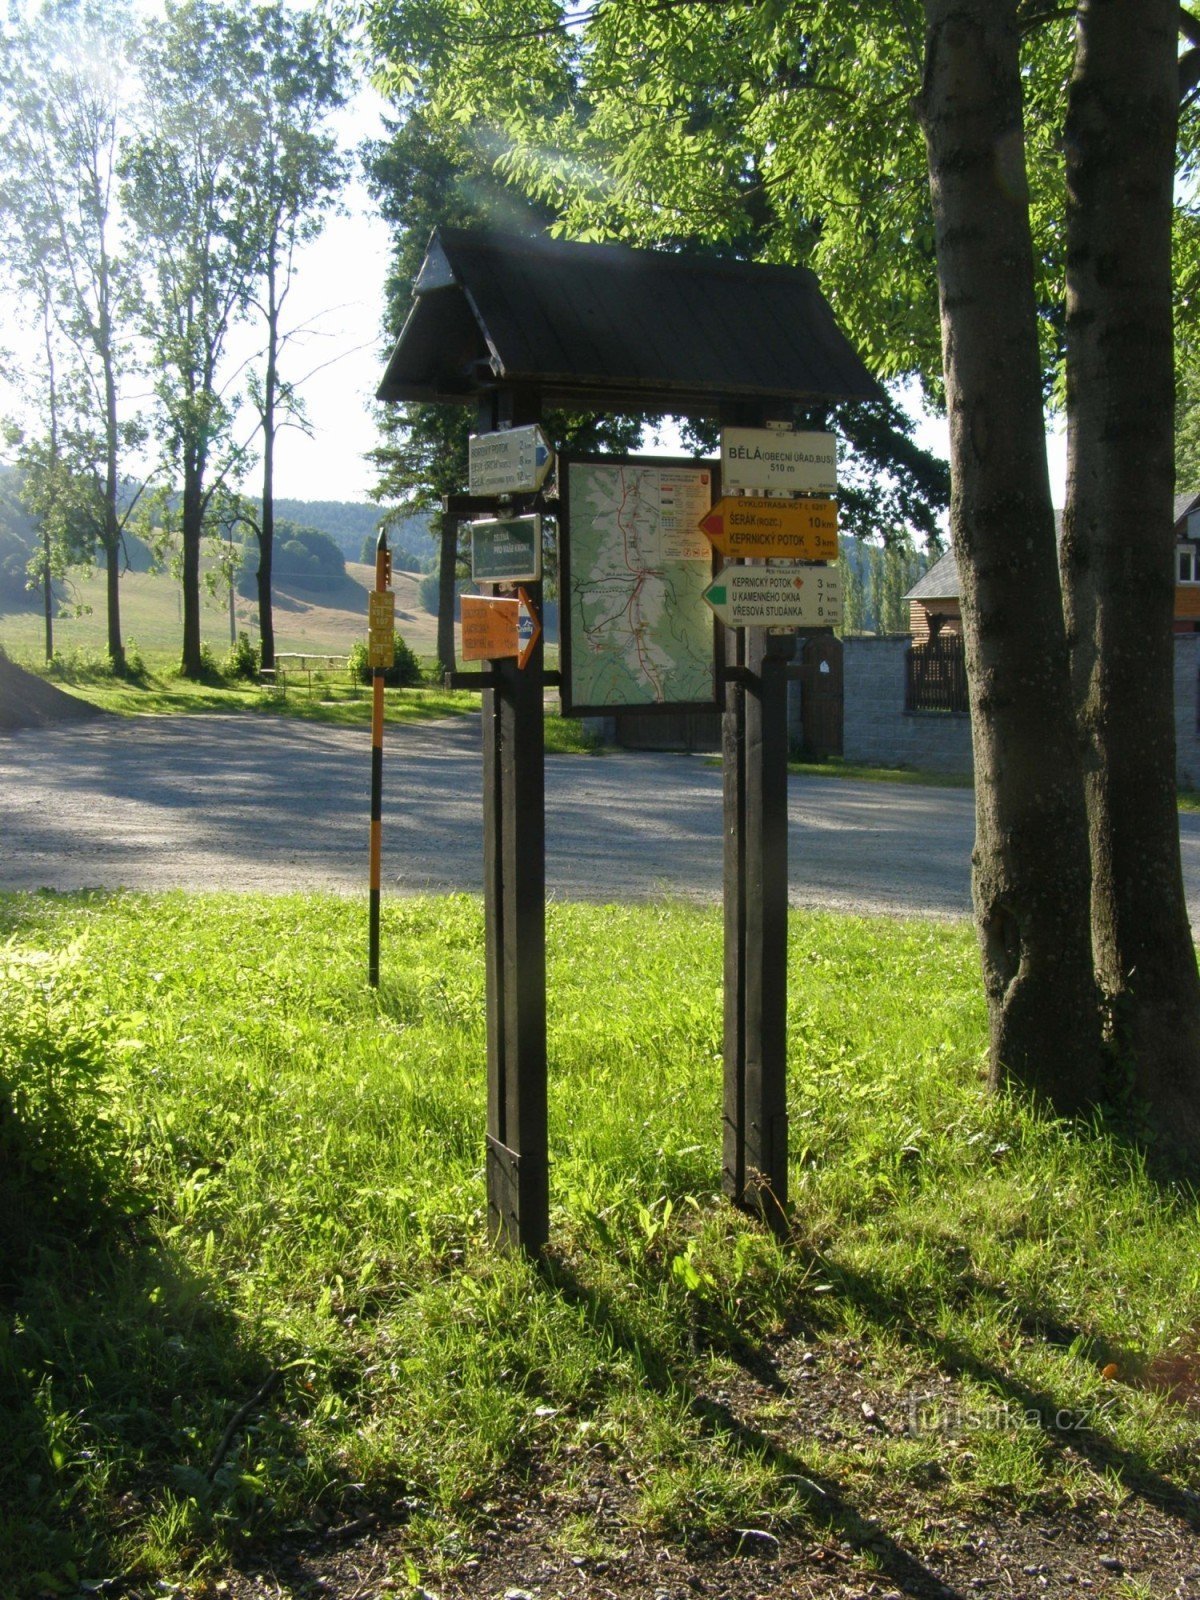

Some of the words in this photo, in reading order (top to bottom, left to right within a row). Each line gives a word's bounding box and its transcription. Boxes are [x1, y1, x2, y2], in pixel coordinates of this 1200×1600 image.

[728, 445, 762, 460] BĚLÁ
[770, 464, 785, 473] 510
[738, 501, 787, 510] CYKLOTRASA
[729, 511, 757, 527] ŠERÁK
[809, 517, 822, 529] 10
[822, 521, 835, 529] km
[729, 531, 776, 547] KEPRNICKÝ
[778, 535, 805, 547] POTOK
[815, 536, 821, 547] 3
[822, 539, 835, 548] km
[732, 576, 769, 589] KEPRNICKÝ
[769, 578, 793, 588] POTOK
[817, 578, 823, 589] 3
[827, 581, 837, 589] km
[732, 592, 738, 602] U
[738, 589, 781, 603] KAMENNÉHO
[782, 591, 801, 602] OKNA
[817, 592, 823, 603] 7
[827, 595, 837, 603] km
[732, 603, 765, 617] VŘESOVÁ
[765, 604, 803, 617] STUDÁNKA
[817, 606, 824, 617] 8
[828, 608, 838, 617] km
